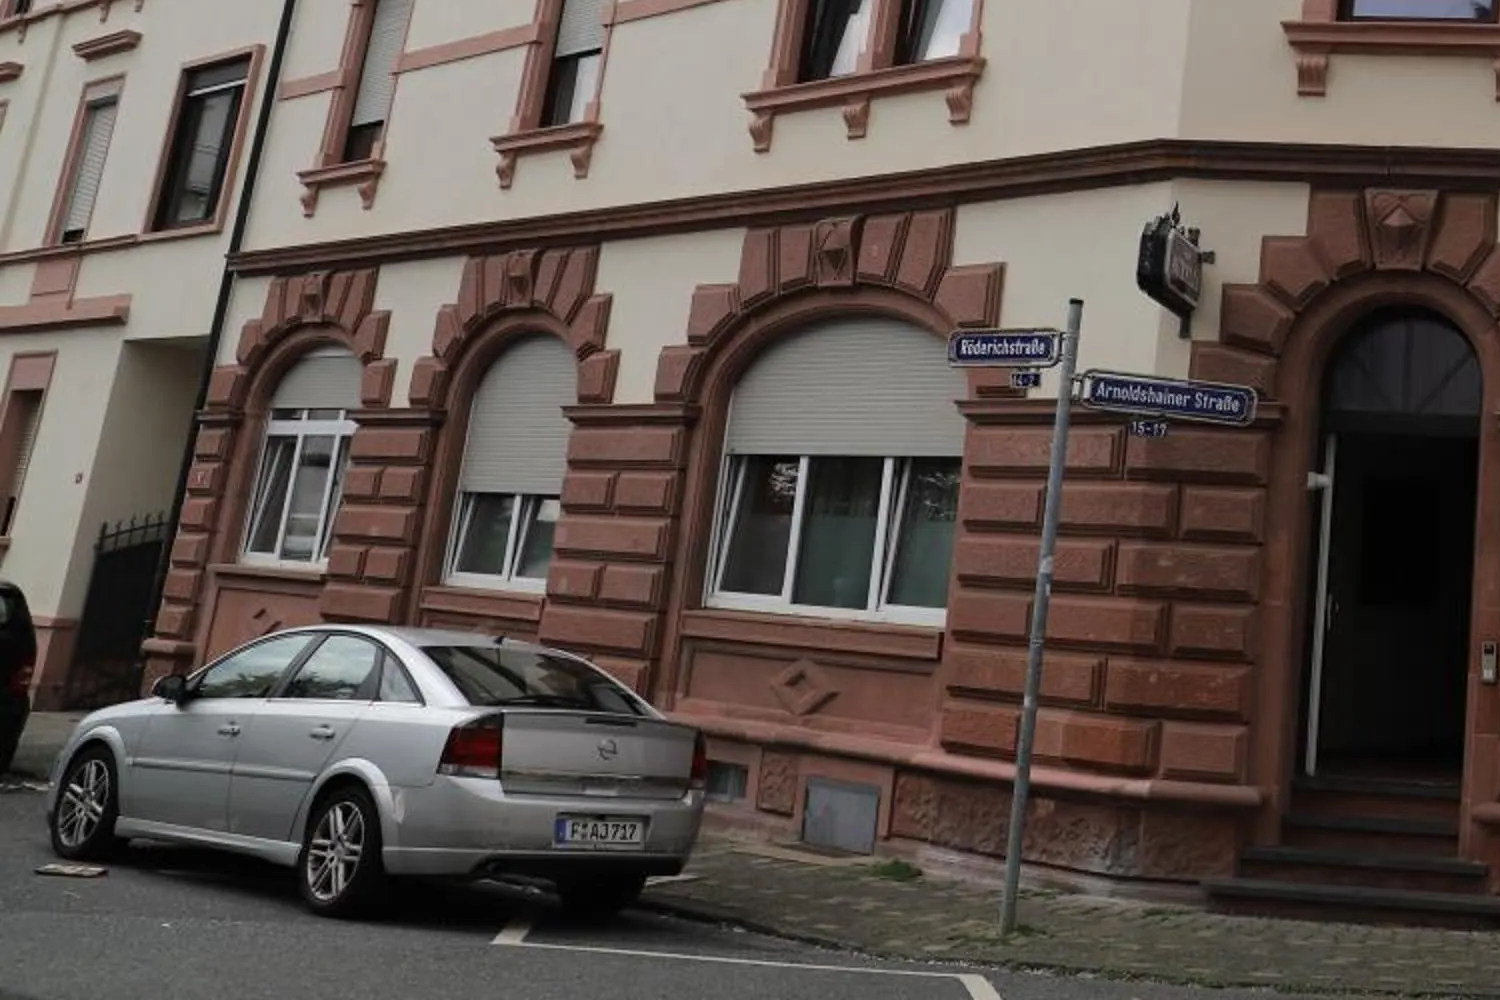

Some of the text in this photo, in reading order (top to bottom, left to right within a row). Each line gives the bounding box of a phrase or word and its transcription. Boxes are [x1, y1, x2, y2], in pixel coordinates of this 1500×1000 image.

[960, 337, 1045, 356] Röderichstraße
[1096, 382, 1241, 412] Arnoldshainer Straße
[1132, 420, 1167, 438] 15-17
